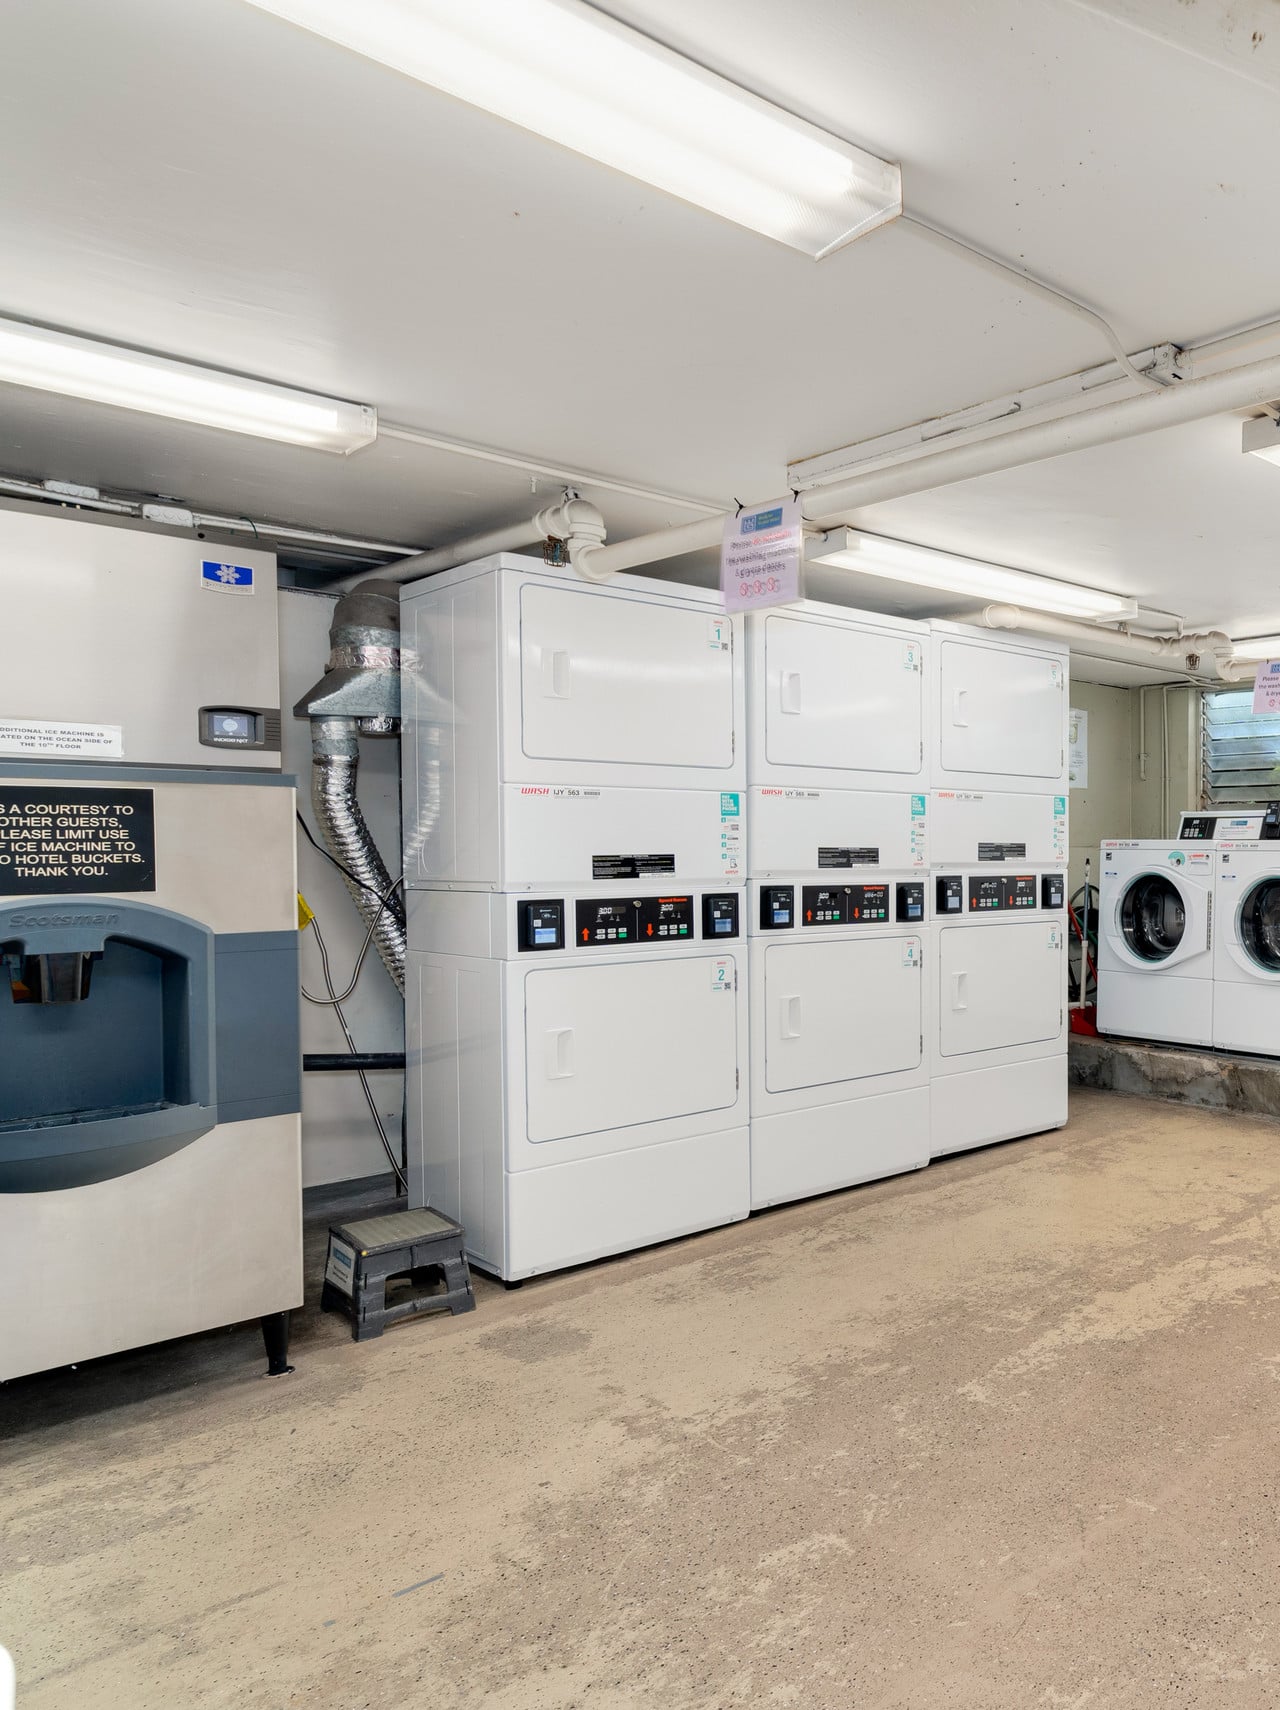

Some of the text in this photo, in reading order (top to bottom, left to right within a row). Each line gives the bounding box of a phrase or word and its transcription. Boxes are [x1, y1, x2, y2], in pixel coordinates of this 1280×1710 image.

[715, 628, 720, 640] 1
[908, 651, 913, 662] 3
[0, 804, 134, 815] S A COURTESY TO
[0, 816, 122, 828] OTHER GUESTS,
[0, 830, 130, 839] LEASE LIMIT USE
[10, 842, 37, 852] ICE
[41, 842, 112, 852] MACHINE
[115, 841, 136, 851] TO
[0, 853, 145, 865] O HOTEL BUCKETS.
[14, 866, 108, 877] THANK YOU.
[9, 913, 120, 928] Scotsman
[1050, 932, 1056, 942] 6
[908, 948, 913, 958] 4
[718, 969, 724, 981] 2
